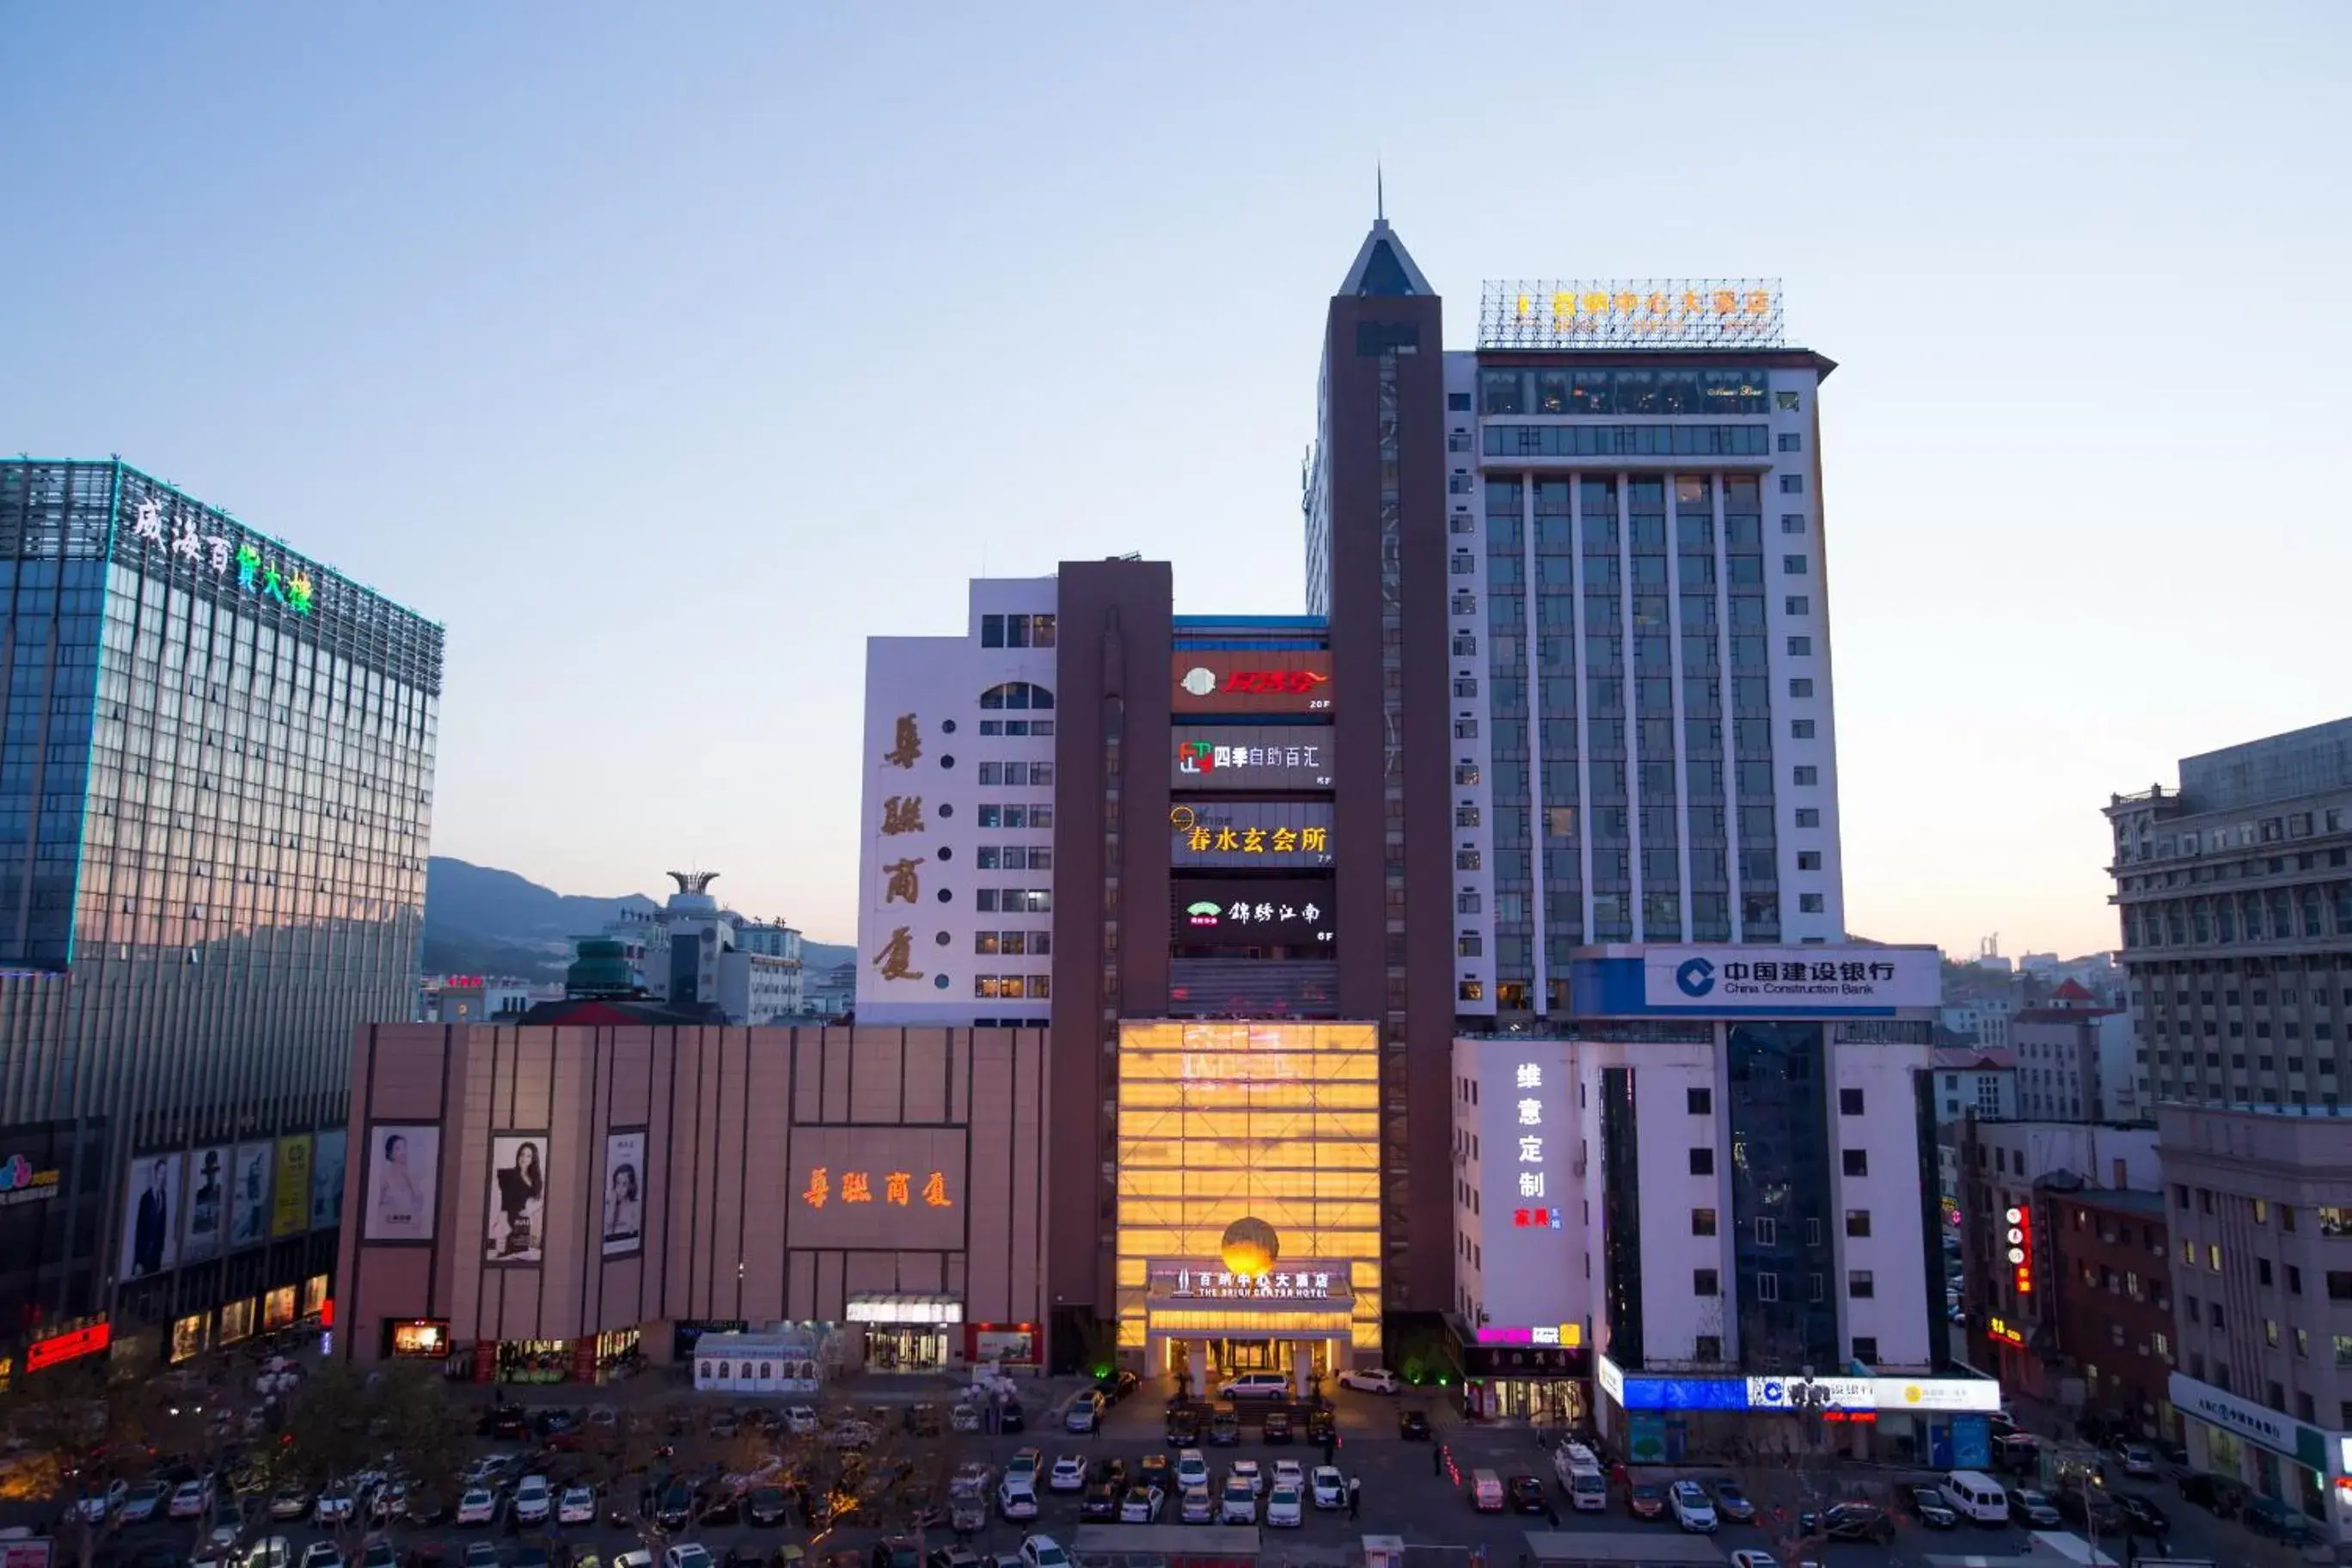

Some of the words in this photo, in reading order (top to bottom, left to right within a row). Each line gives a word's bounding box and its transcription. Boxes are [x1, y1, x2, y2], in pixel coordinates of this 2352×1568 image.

[1309, 700, 1331, 708] 20F
[1214, 745, 1320, 768] 四季自助百汇
[1186, 825, 1327, 852] 春水玄会所
[1724, 962, 1895, 981] 中国建设银行
[1725, 983, 1759, 995] China
[1763, 983, 1839, 995] Construction
[1841, 983, 1874, 995] Bank
[1516, 1063, 1545, 1197] 维意定制
